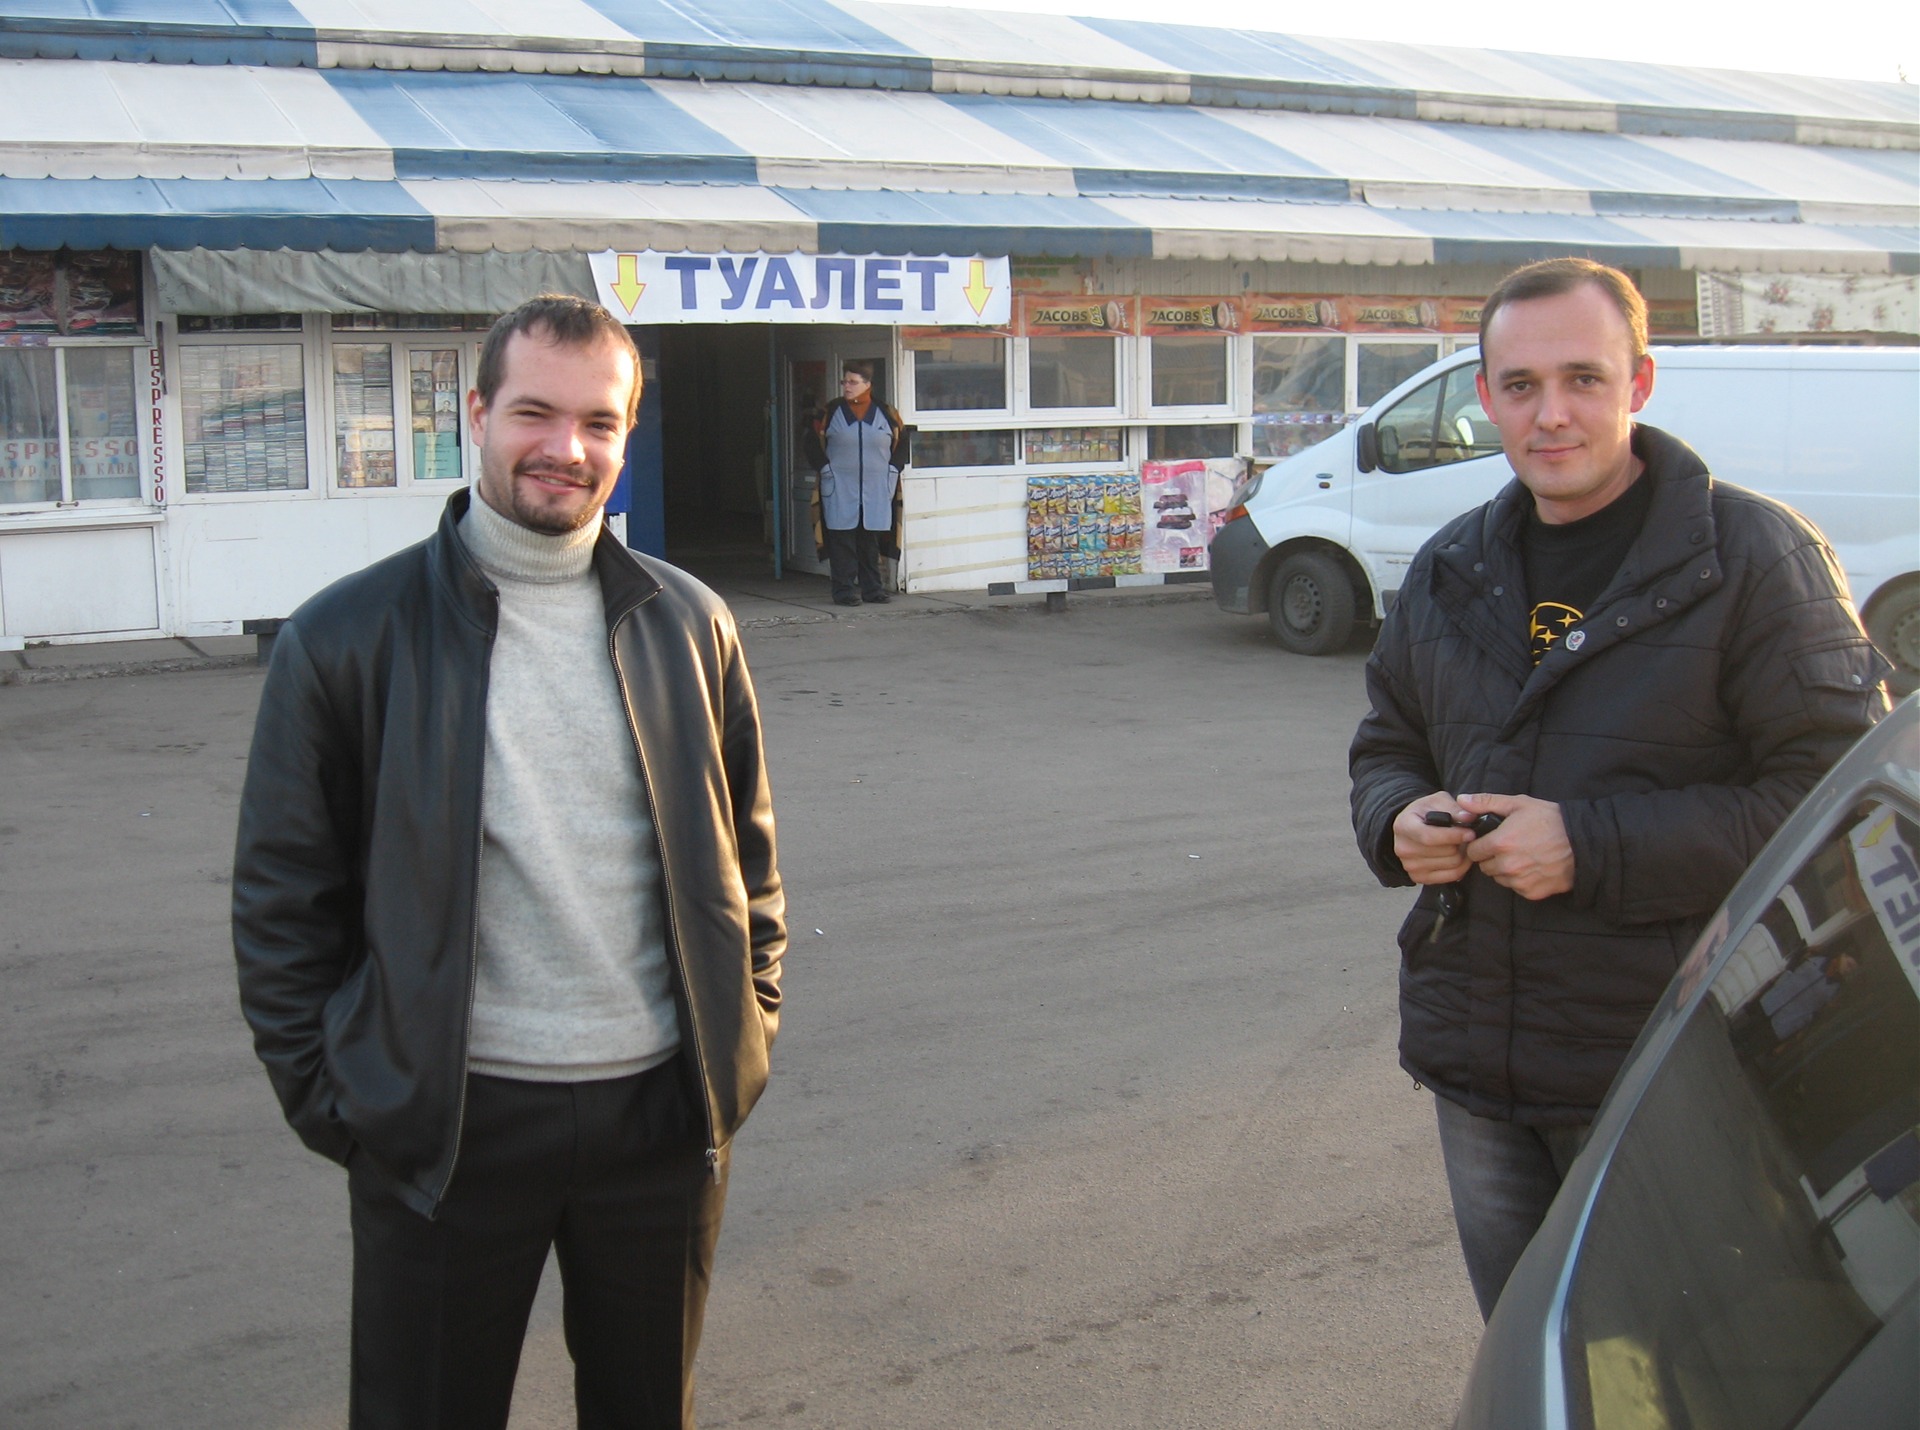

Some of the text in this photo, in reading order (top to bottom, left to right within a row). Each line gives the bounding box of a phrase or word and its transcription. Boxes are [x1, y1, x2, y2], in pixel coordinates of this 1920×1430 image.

[664, 257, 949, 311] ТУАЛЕТ
[1033, 310, 1088, 324] JACOBS
[1148, 310, 1199, 323] JACOBS
[1254, 308, 1303, 319] JACOBS
[1359, 308, 1404, 320] JACOBS
[1457, 309, 1483, 320] JAC
[150, 349, 165, 502] ESPRESSO
[4, 439, 138, 461] SPRESSO
